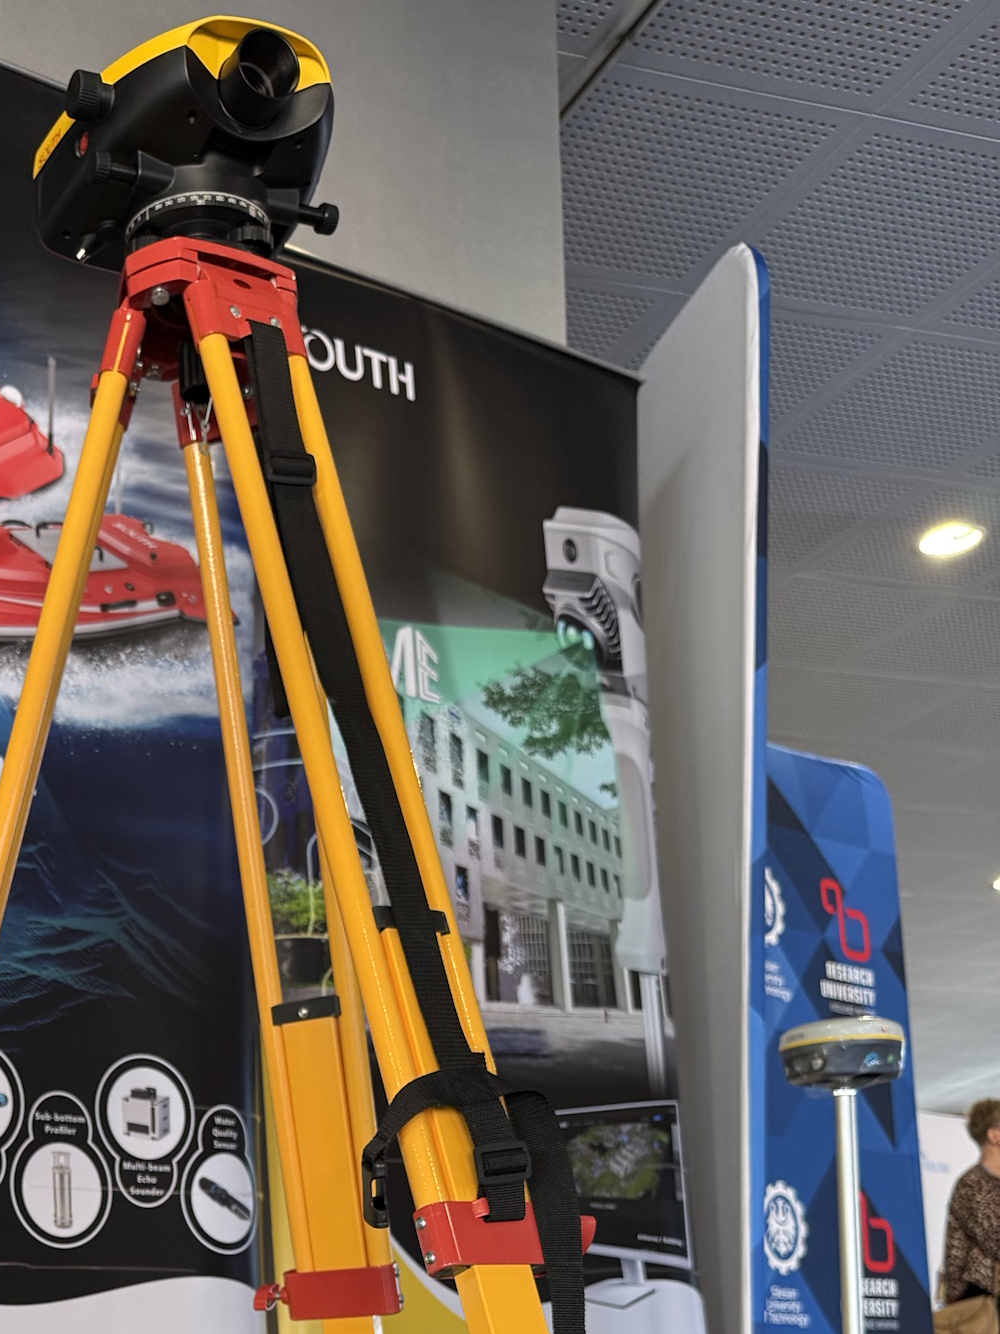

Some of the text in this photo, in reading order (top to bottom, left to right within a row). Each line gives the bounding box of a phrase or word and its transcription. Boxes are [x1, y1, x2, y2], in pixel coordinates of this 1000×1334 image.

[303, 328, 416, 402] OUTH
[825, 960, 876, 987] RESEARCH
[820, 978, 877, 1007] UNIVERSITY
[35, 1111, 86, 1124] Sub-bottom
[44, 1125, 77, 1137] Profiler
[123, 1161, 171, 1173] Multi-beam
[137, 1175, 158, 1184] Echo
[129, 1187, 165, 1197] Sounder
[861, 1277, 898, 1298] SEARCH
[863, 1298, 899, 1318] ERSITY
